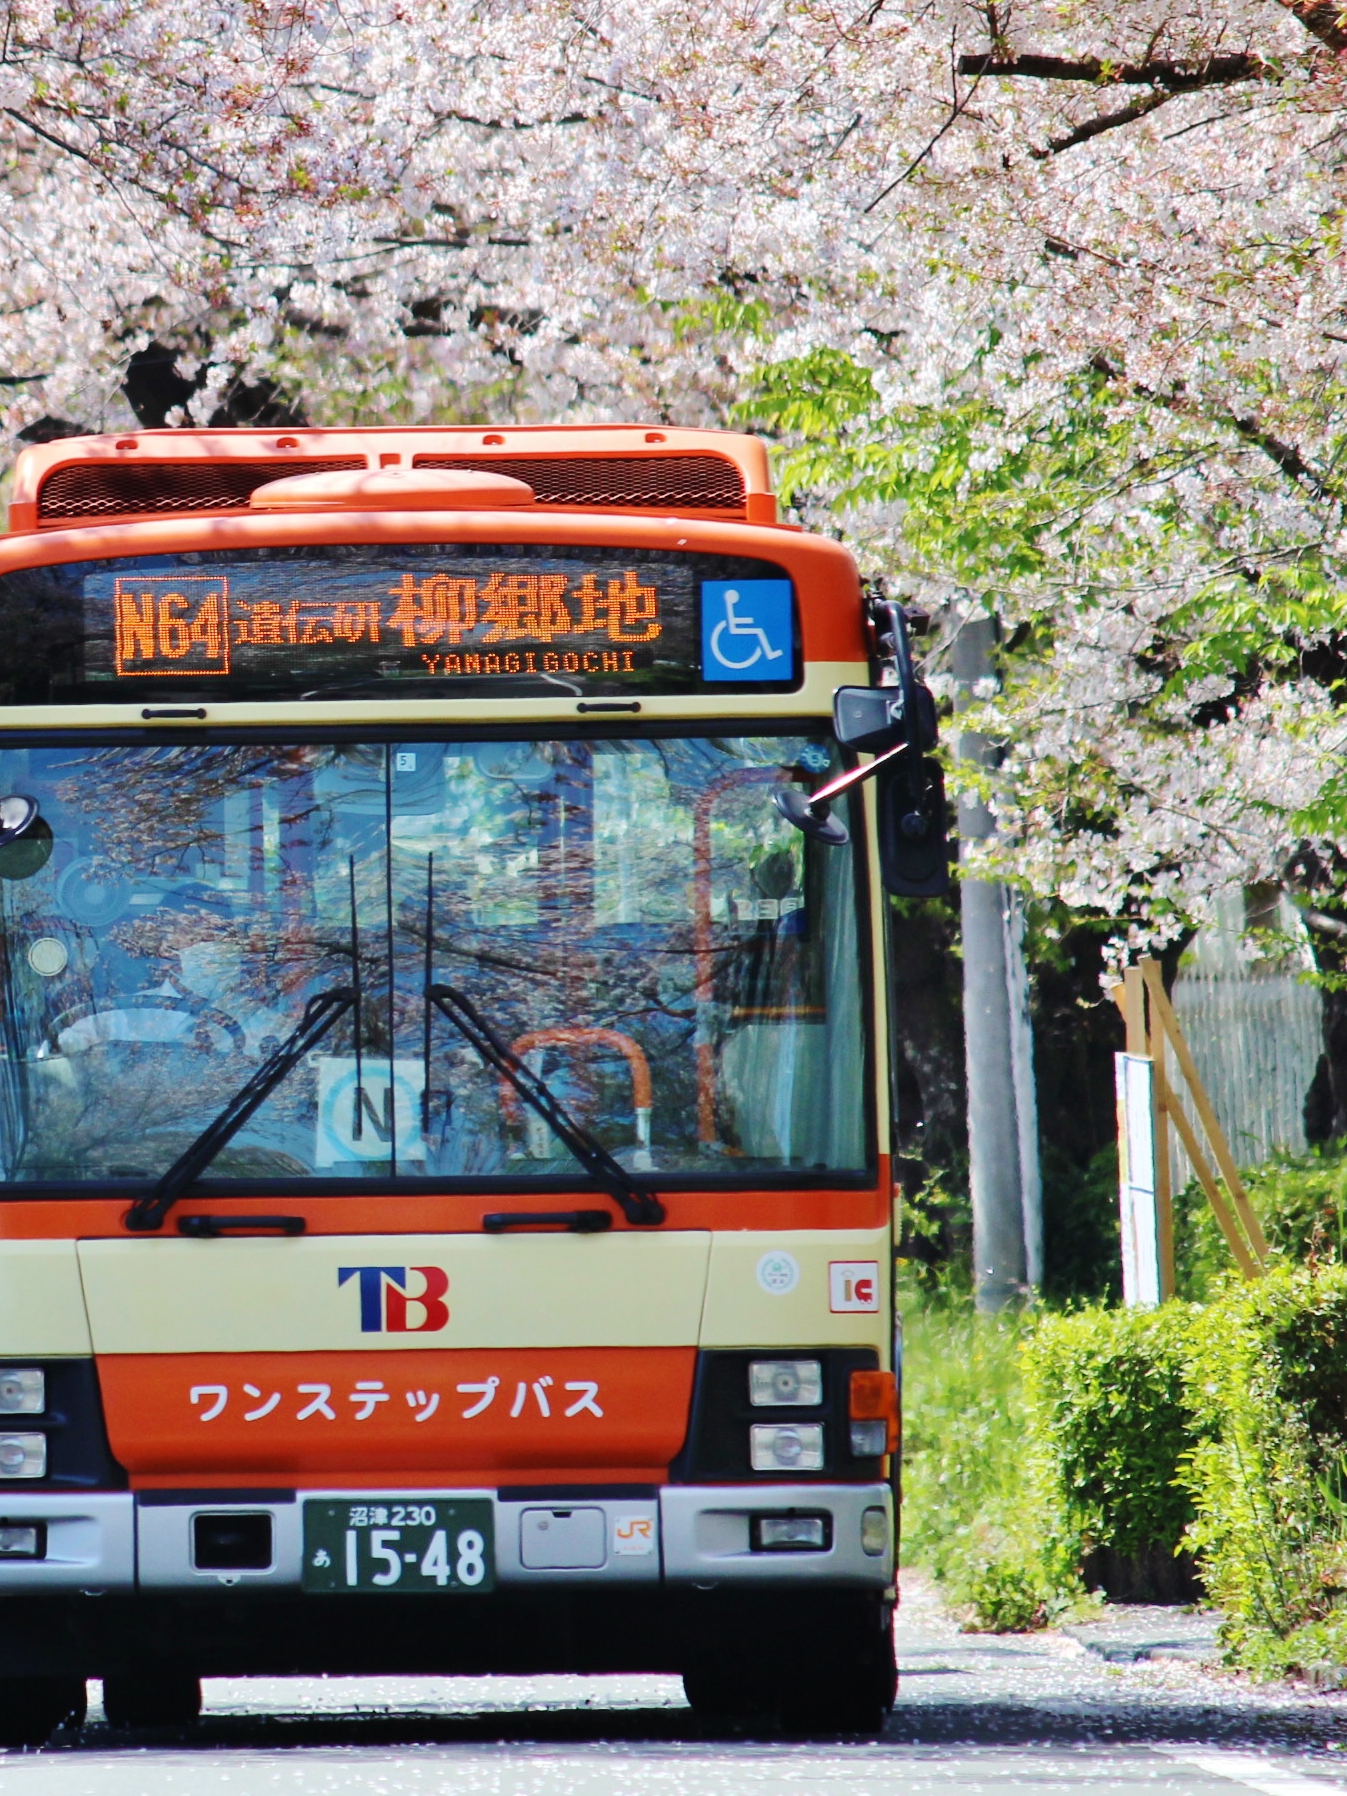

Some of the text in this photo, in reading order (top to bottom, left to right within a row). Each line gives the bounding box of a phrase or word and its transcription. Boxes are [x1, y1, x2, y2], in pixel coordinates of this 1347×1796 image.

[121, 571, 662, 659] N64 遺伝研 柳郷地
[421, 651, 635, 675] YANAGIGOCHI
[352, 1086, 394, 1142] N
[338, 1266, 449, 1332] TB
[189, 1375, 604, 1422] ワンステップバス
[345, 1529, 485, 1586] 15-48
[617, 1520, 651, 1539] JR
